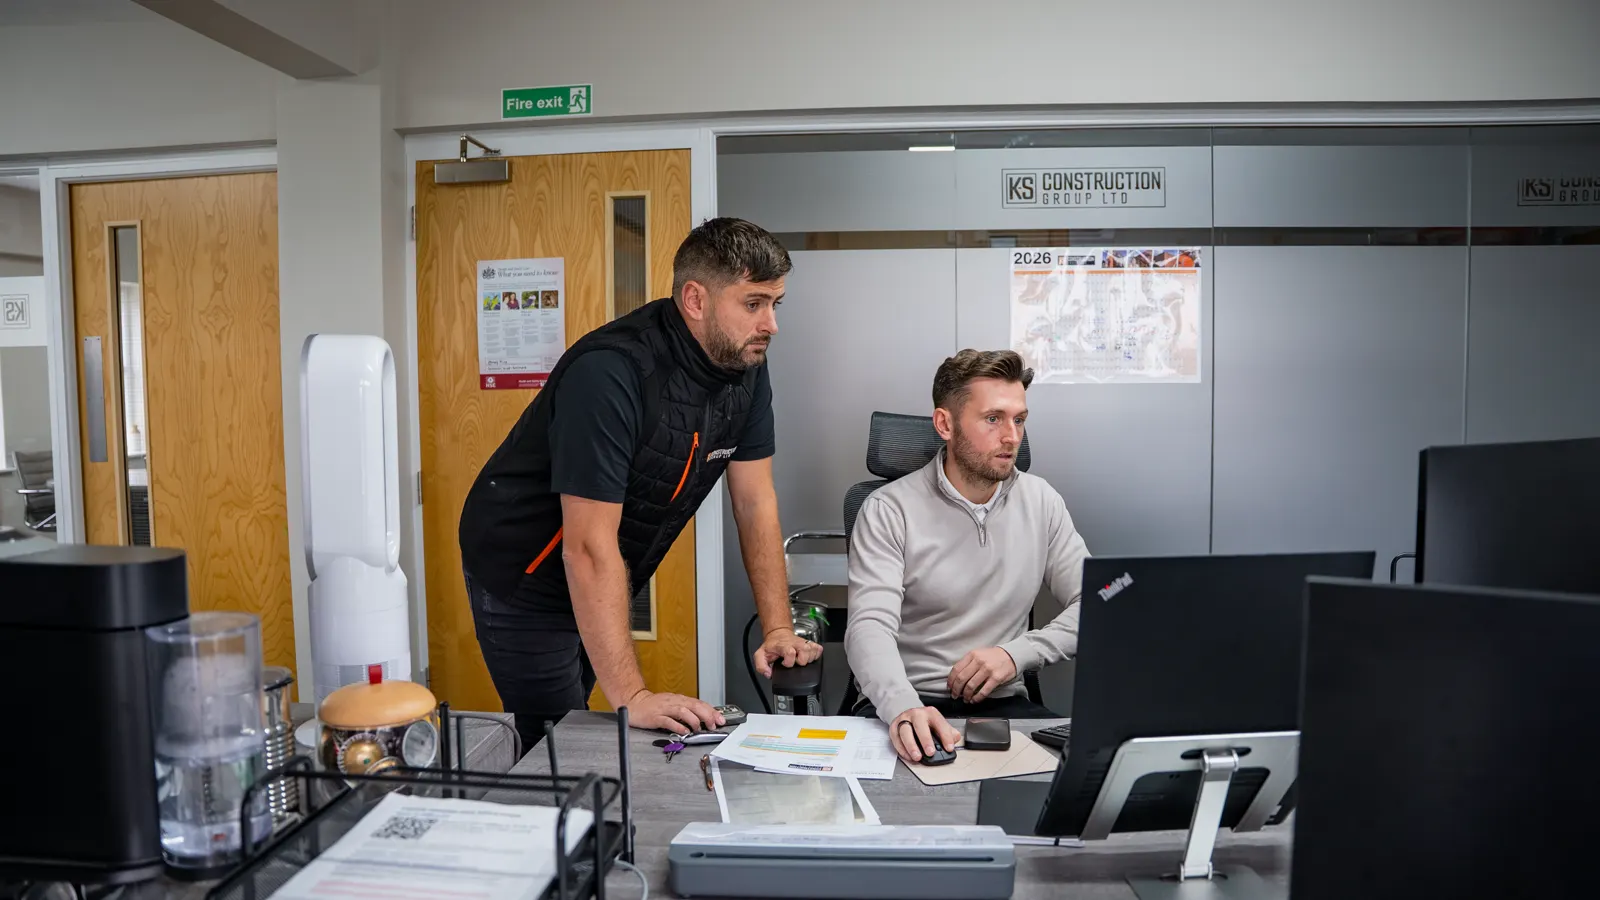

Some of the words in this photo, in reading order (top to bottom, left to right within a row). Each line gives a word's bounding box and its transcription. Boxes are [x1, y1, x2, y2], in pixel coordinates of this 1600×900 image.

[506, 98, 533, 111] Fire
[536, 95, 563, 109] exit
[1009, 176, 1034, 200] KS
[1042, 171, 1161, 191] CONSTRUCTION
[1042, 192, 1092, 205] GROUP
[1102, 192, 1128, 205] LTD
[1014, 252, 1052, 265] 2026
[497, 270, 512, 278] What
[1097, 571, 1134, 602] ThinkPad
